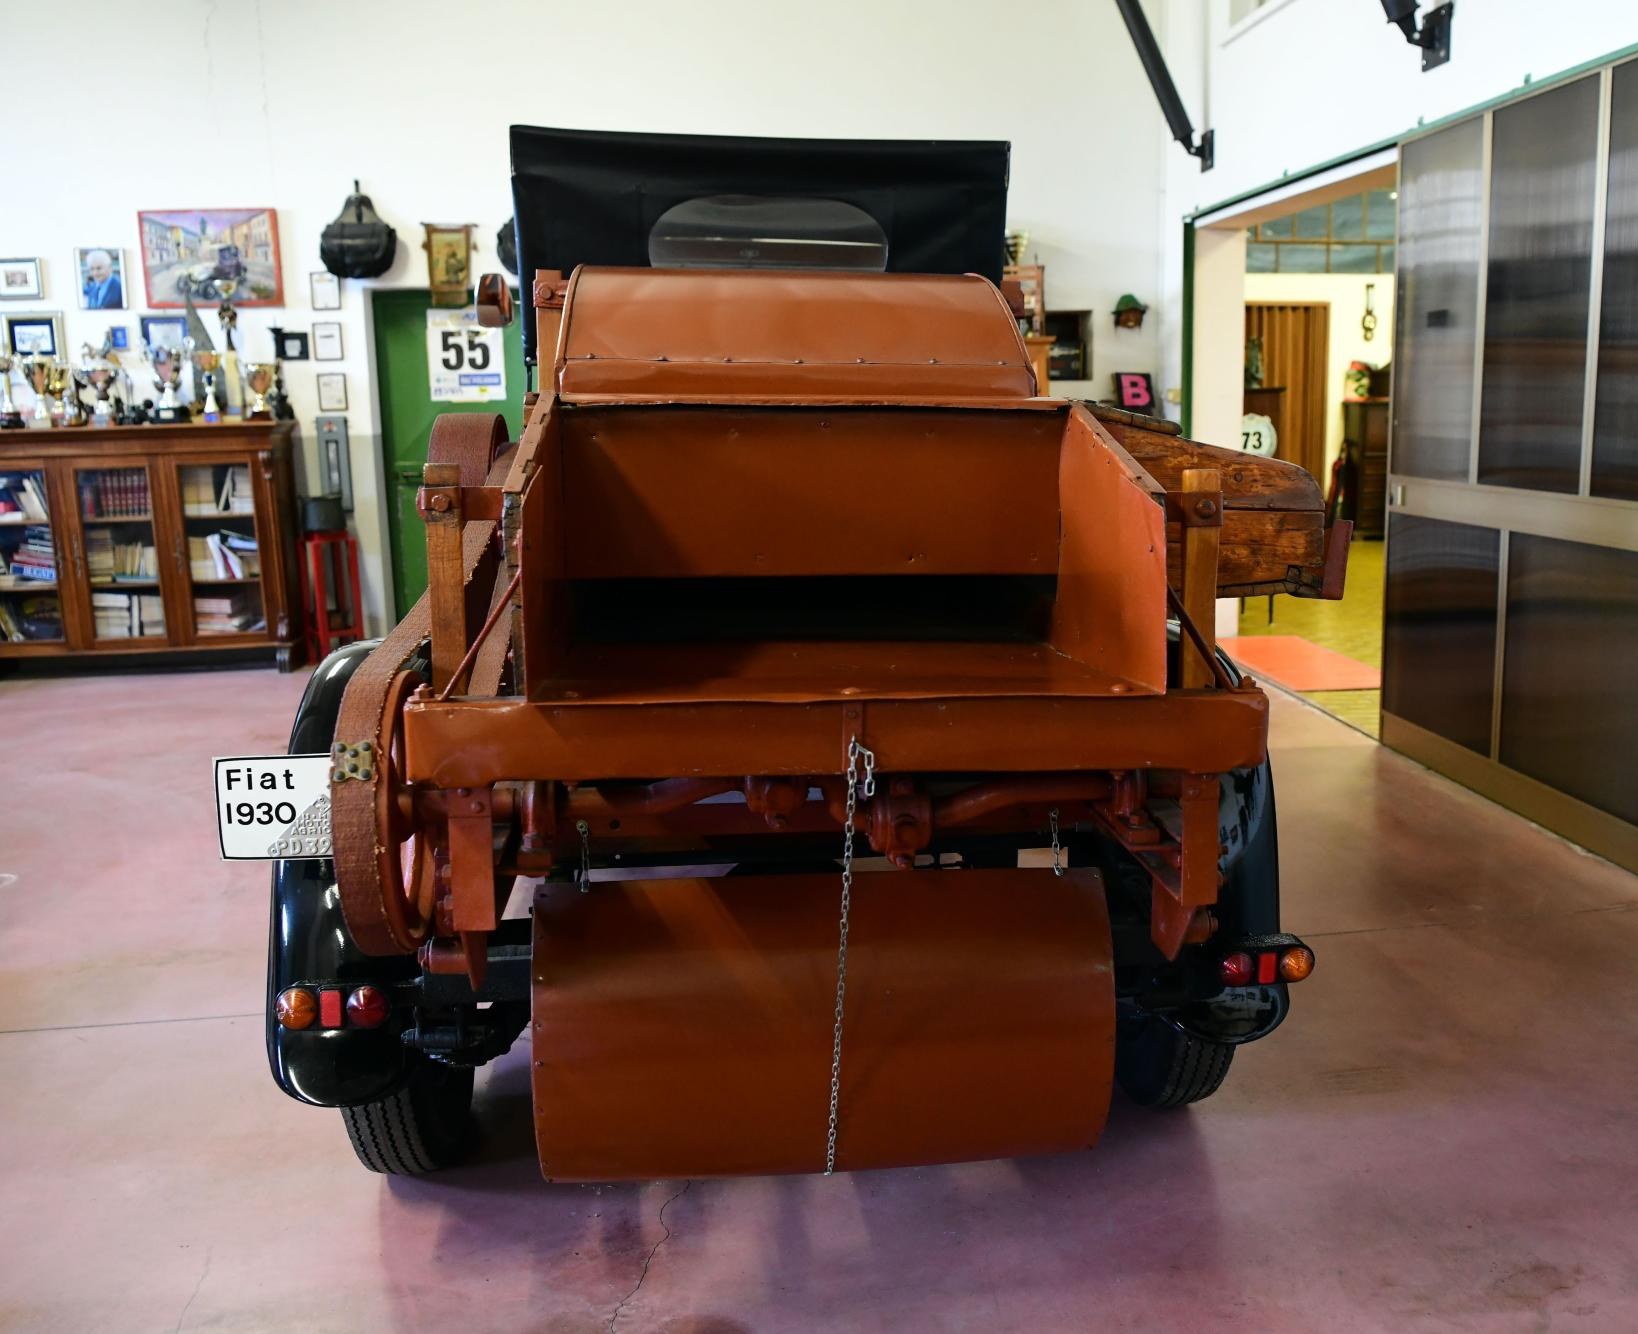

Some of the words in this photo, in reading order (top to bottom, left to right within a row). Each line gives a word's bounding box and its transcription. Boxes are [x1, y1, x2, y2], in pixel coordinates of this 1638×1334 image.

[441, 329, 490, 371] 55
[1121, 375, 1151, 407] B
[1242, 431, 1263, 450] 73
[226, 767, 295, 791] Fiat
[226, 801, 297, 826] 1930
[296, 818, 331, 828] MOTO
[290, 826, 332, 836] AGRIC
